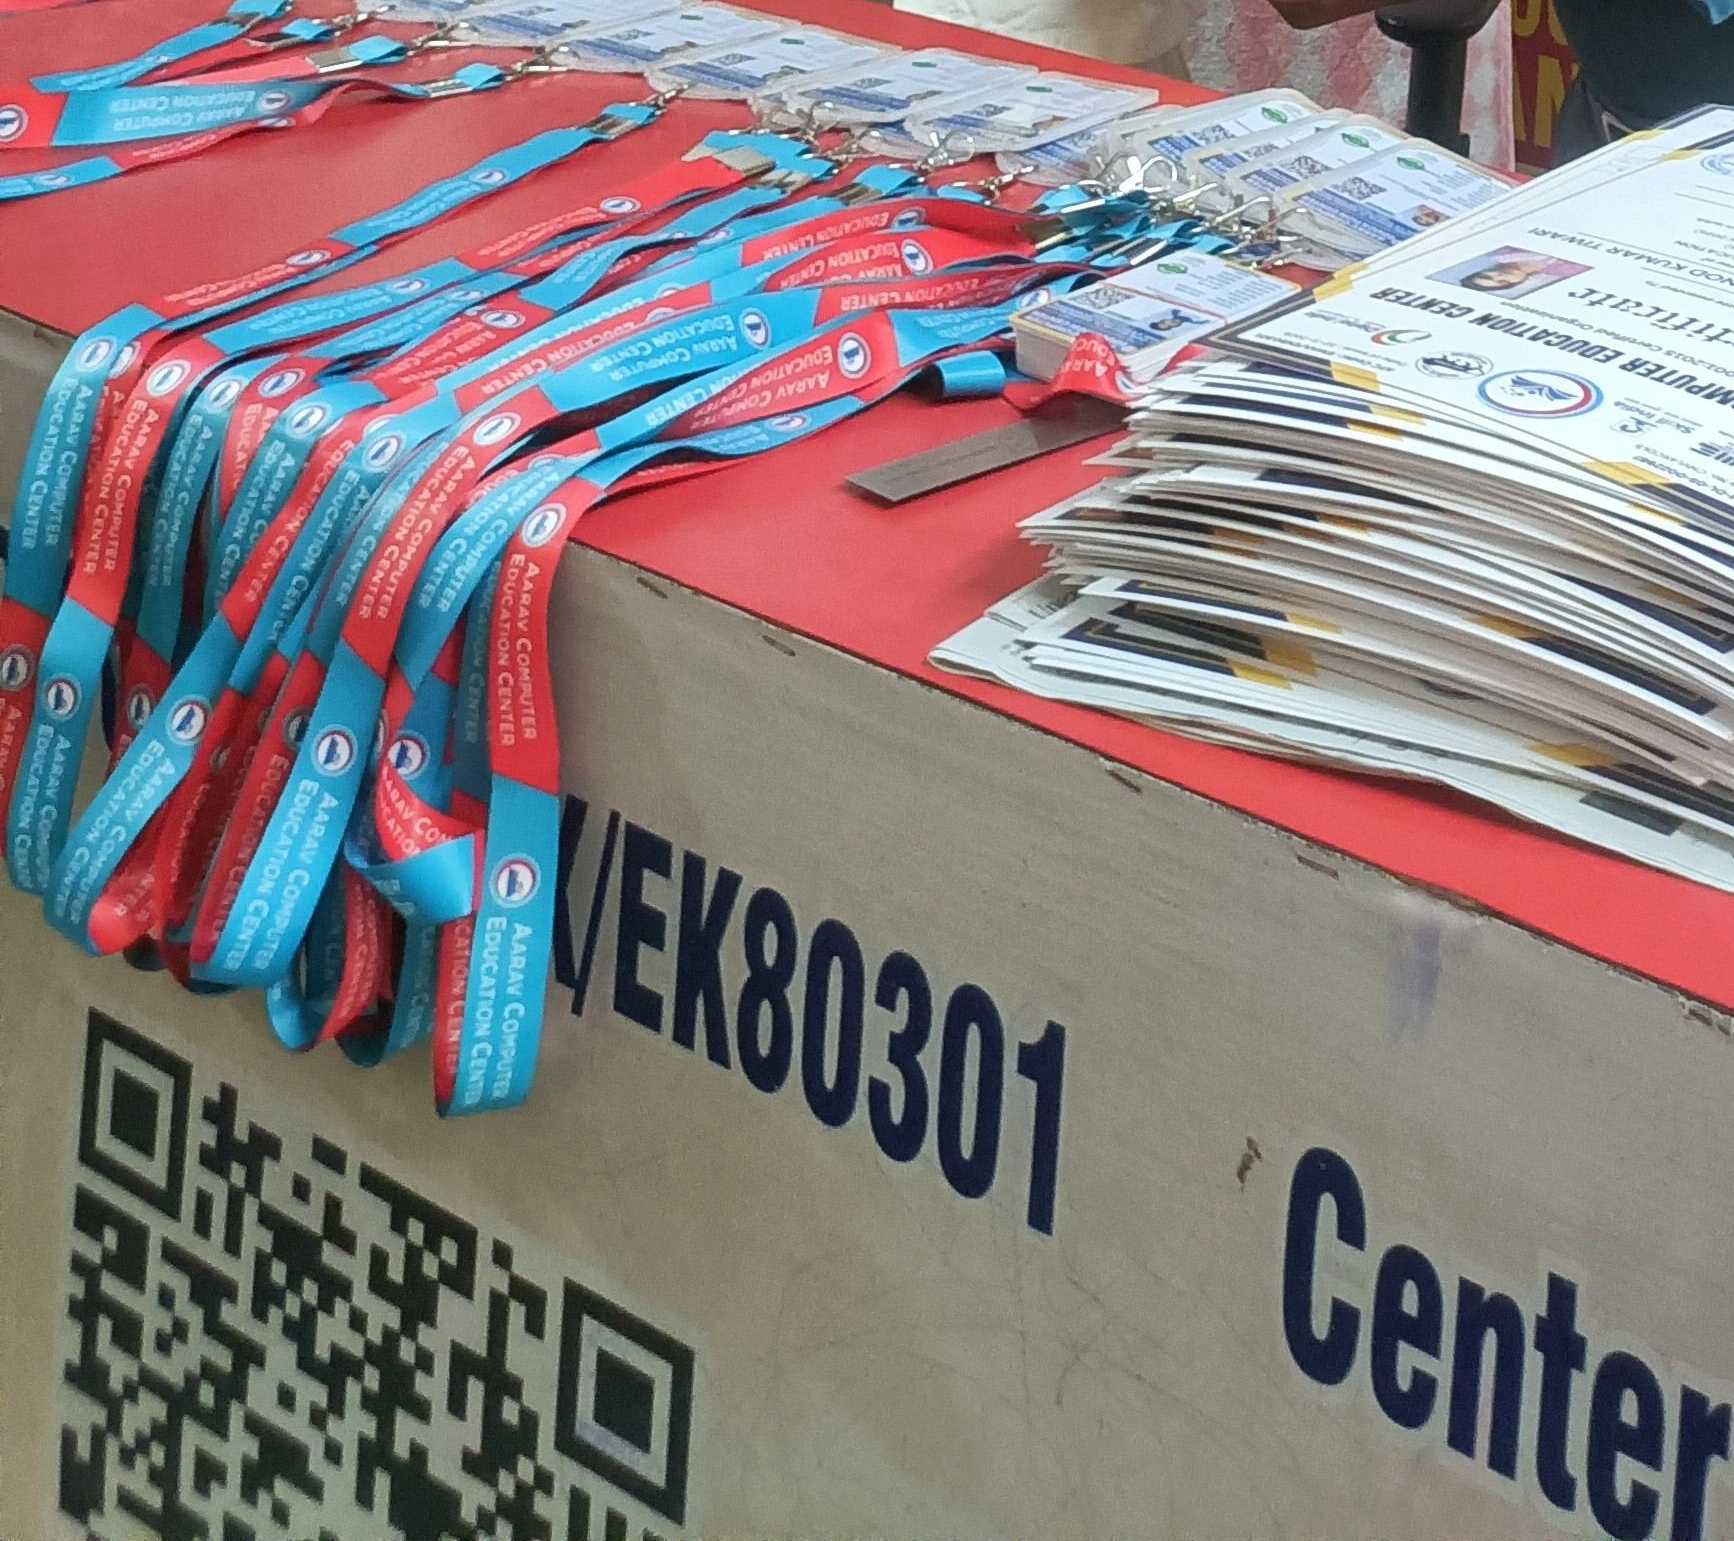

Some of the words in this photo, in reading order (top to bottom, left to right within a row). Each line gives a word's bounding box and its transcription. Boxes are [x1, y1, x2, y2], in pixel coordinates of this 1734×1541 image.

[1528, 227, 1603, 253] TIWARI
[1607, 245, 1687, 273] KUMAR
[1369, 287, 1475, 319] CENTER
[1467, 311, 1625, 365] EDUCATION
[591, 339, 652, 373] CENTER
[396, 445, 469, 541] EDUCATION
[360, 545, 400, 617] CENTER
[377, 518, 432, 619] COMPUTER
[516, 561, 540, 632] AARAV
[497, 553, 526, 666] EDUCATION
[497, 670, 515, 747] CENTER
[516, 637, 537, 740] COMPUTER
[257, 779, 319, 896] EDUCATION
[300, 791, 339, 864] AARAV
[473, 916, 507, 1038] EDUCATION
[505, 922, 533, 996] AARAV
